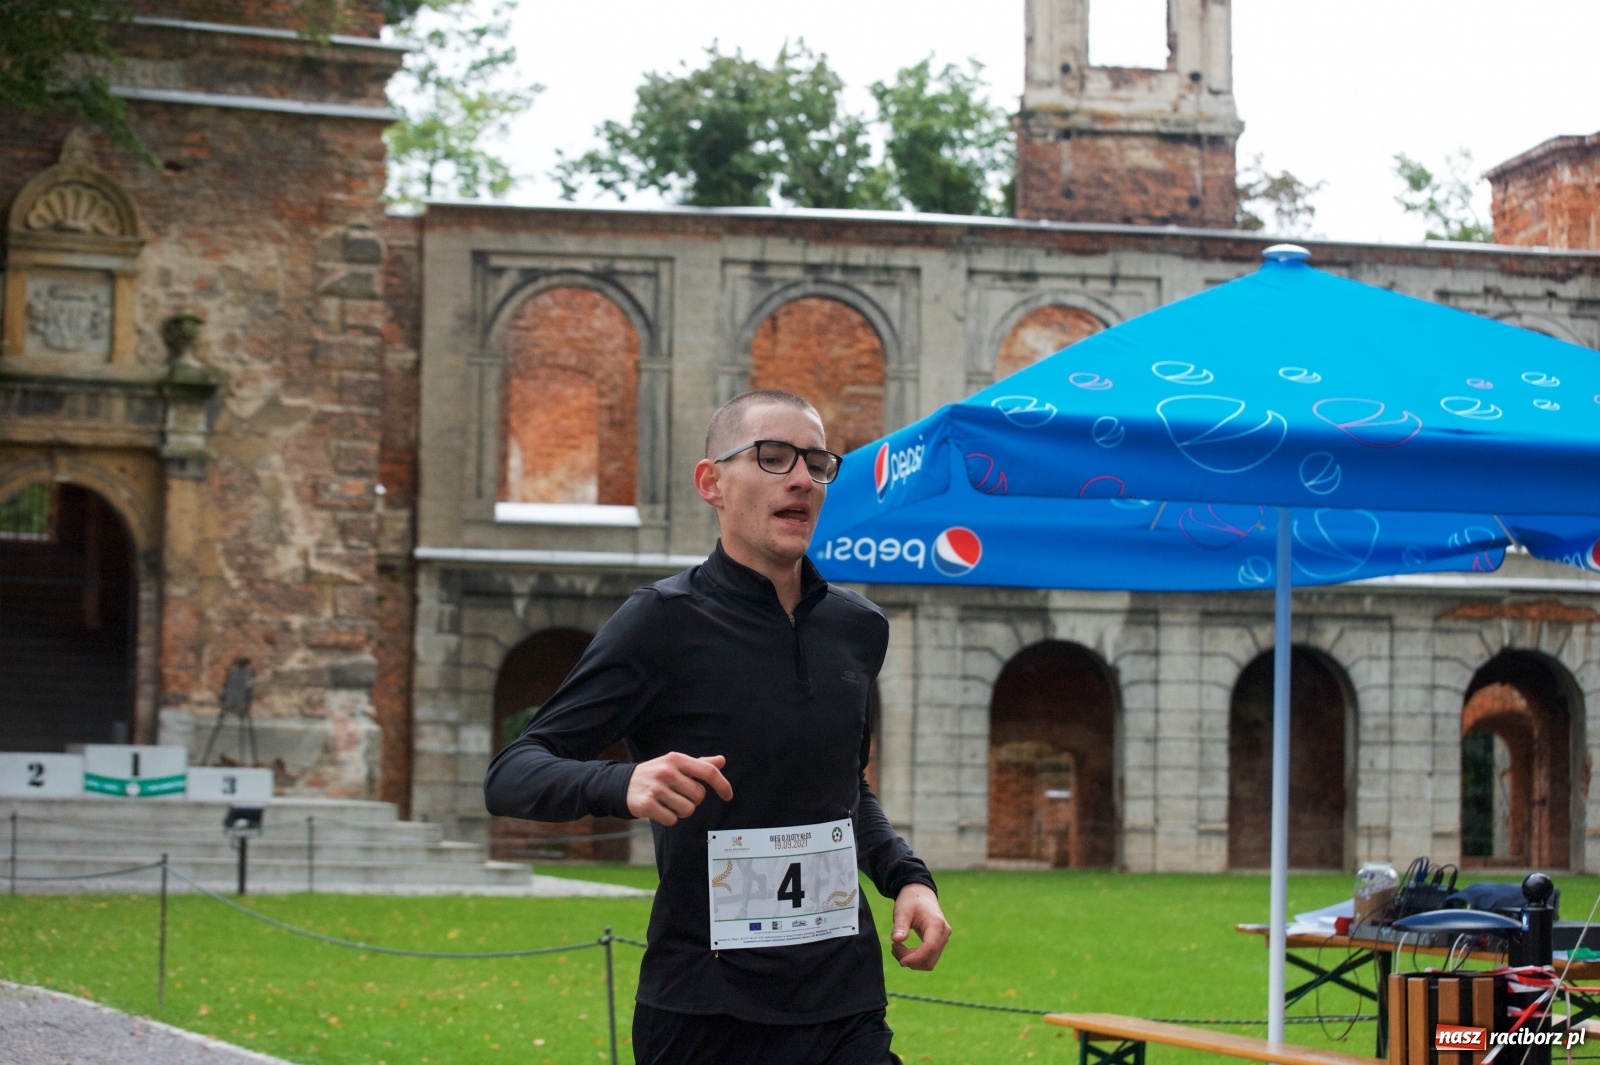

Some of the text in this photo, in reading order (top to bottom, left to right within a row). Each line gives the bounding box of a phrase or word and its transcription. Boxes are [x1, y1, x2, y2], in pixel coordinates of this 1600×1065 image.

[890, 434, 925, 490] pepsi
[27, 762, 45, 787] 2
[131, 752, 141, 777] 1
[222, 775, 237, 795] 3
[769, 834, 781, 842] BIEG
[774, 839, 808, 850] 19.09.2021
[777, 862, 805, 909] 4
